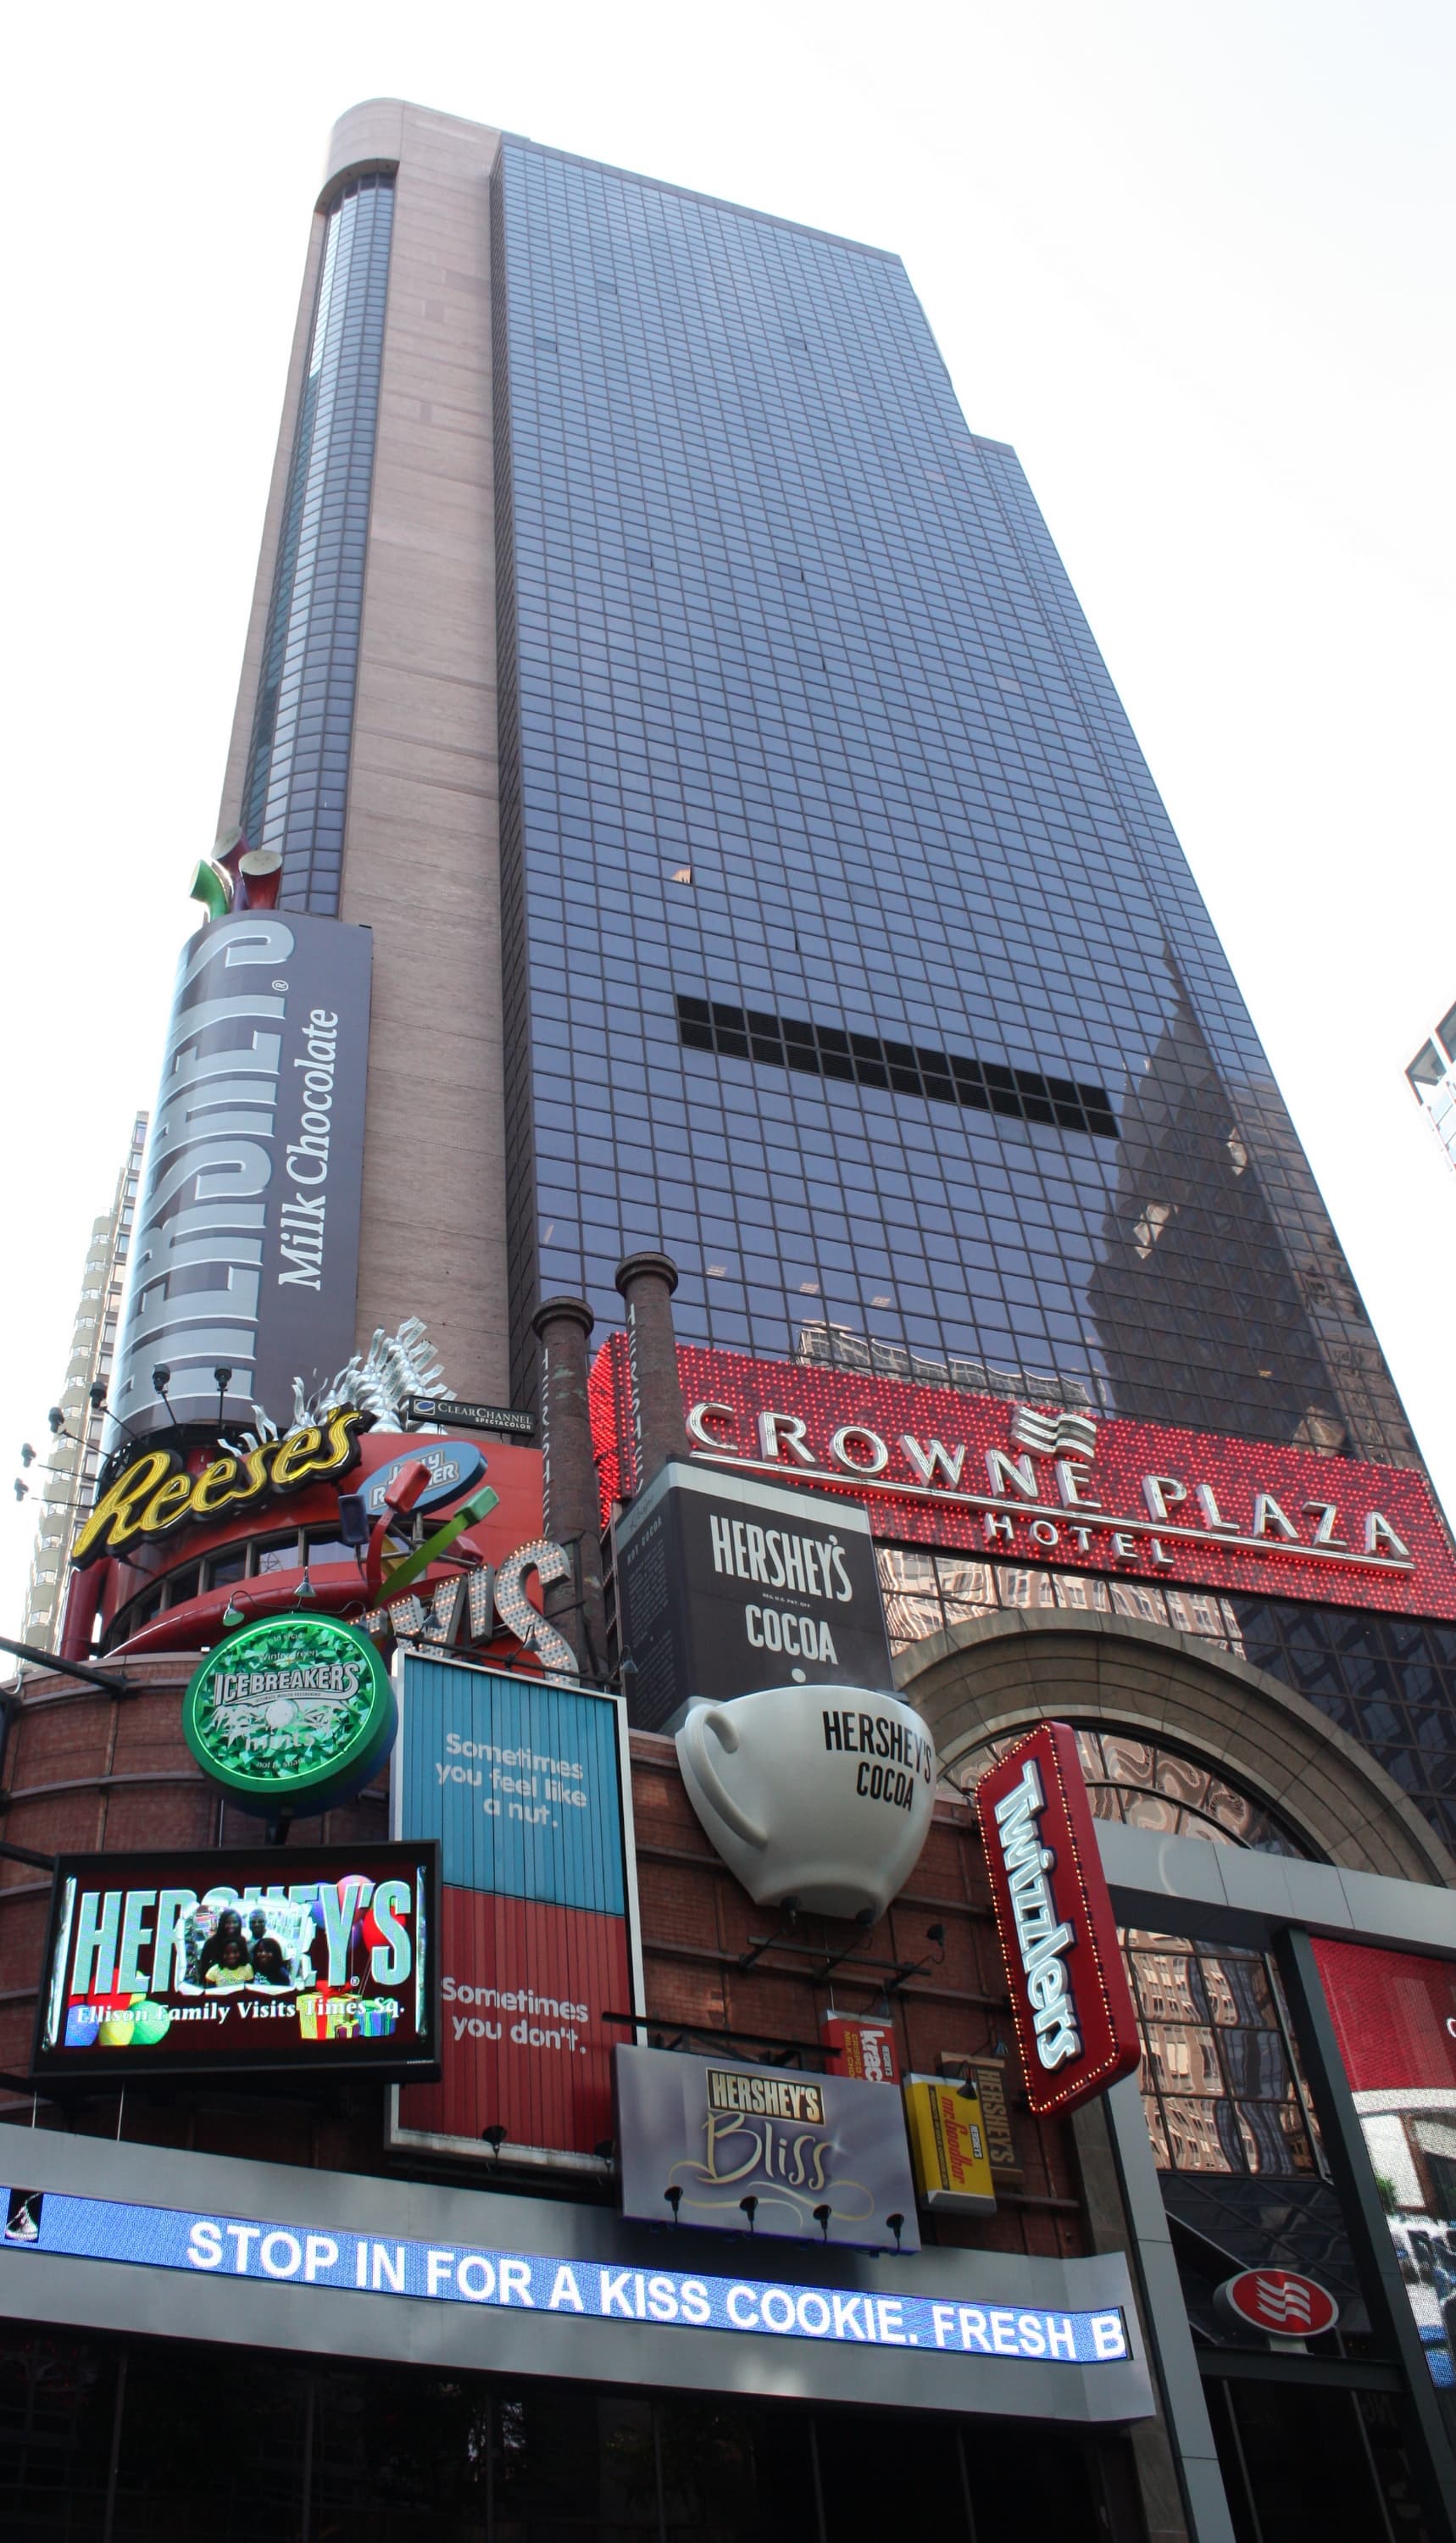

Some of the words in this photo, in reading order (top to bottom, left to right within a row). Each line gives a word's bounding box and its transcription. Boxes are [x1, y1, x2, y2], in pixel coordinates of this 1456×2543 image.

[286, 1009, 339, 1185] Chocolate
[277, 1195, 327, 1291] Milk
[475, 1417, 531, 1431] SPECTACOLOR
[72, 1407, 362, 1558] Reese's
[686, 1402, 1102, 1511] CROWNE
[1142, 1473, 1411, 1558] PLAZA
[709, 1514, 853, 1603] HERSHEY'S
[984, 1511, 1175, 1571] HOTEL
[745, 1604, 839, 1666] COCOA
[446, 1733, 584, 1780] Sometimes
[822, 1711, 932, 1784] HERSHEY'S
[436, 1762, 482, 1786] you
[489, 1768, 537, 1798] feel
[545, 1778, 587, 1808] like
[483, 1797, 501, 1817] a
[509, 1801, 559, 1828] nut.
[856, 1761, 914, 1811] COCOA
[994, 1759, 1082, 2071] Twizzlers
[77, 2006, 149, 2023] Ellison
[156, 2003, 231, 2025] Family
[236, 2000, 297, 2018] Visits
[304, 1998, 364, 2016] Times
[375, 1996, 406, 2019] Sq.
[442, 1977, 589, 2023] Sometimes
[452, 2016, 503, 2041] you
[510, 2019, 586, 2054] don't.
[859, 2030, 886, 2083] krac
[711, 2072, 820, 2123] HERSHEY'S
[977, 2069, 1015, 2163] HERSHEY'S
[697, 2111, 834, 2190] Bliss
[186, 2219, 340, 2283] STOP
[356, 2240, 408, 2294] IN
[426, 2249, 534, 2307] FOR
[547, 2264, 585, 2312] A
[599, 2270, 711, 2324] KISS
[726, 2284, 917, 2346] COOKIE.
[931, 2309, 1078, 2360] FRESH
